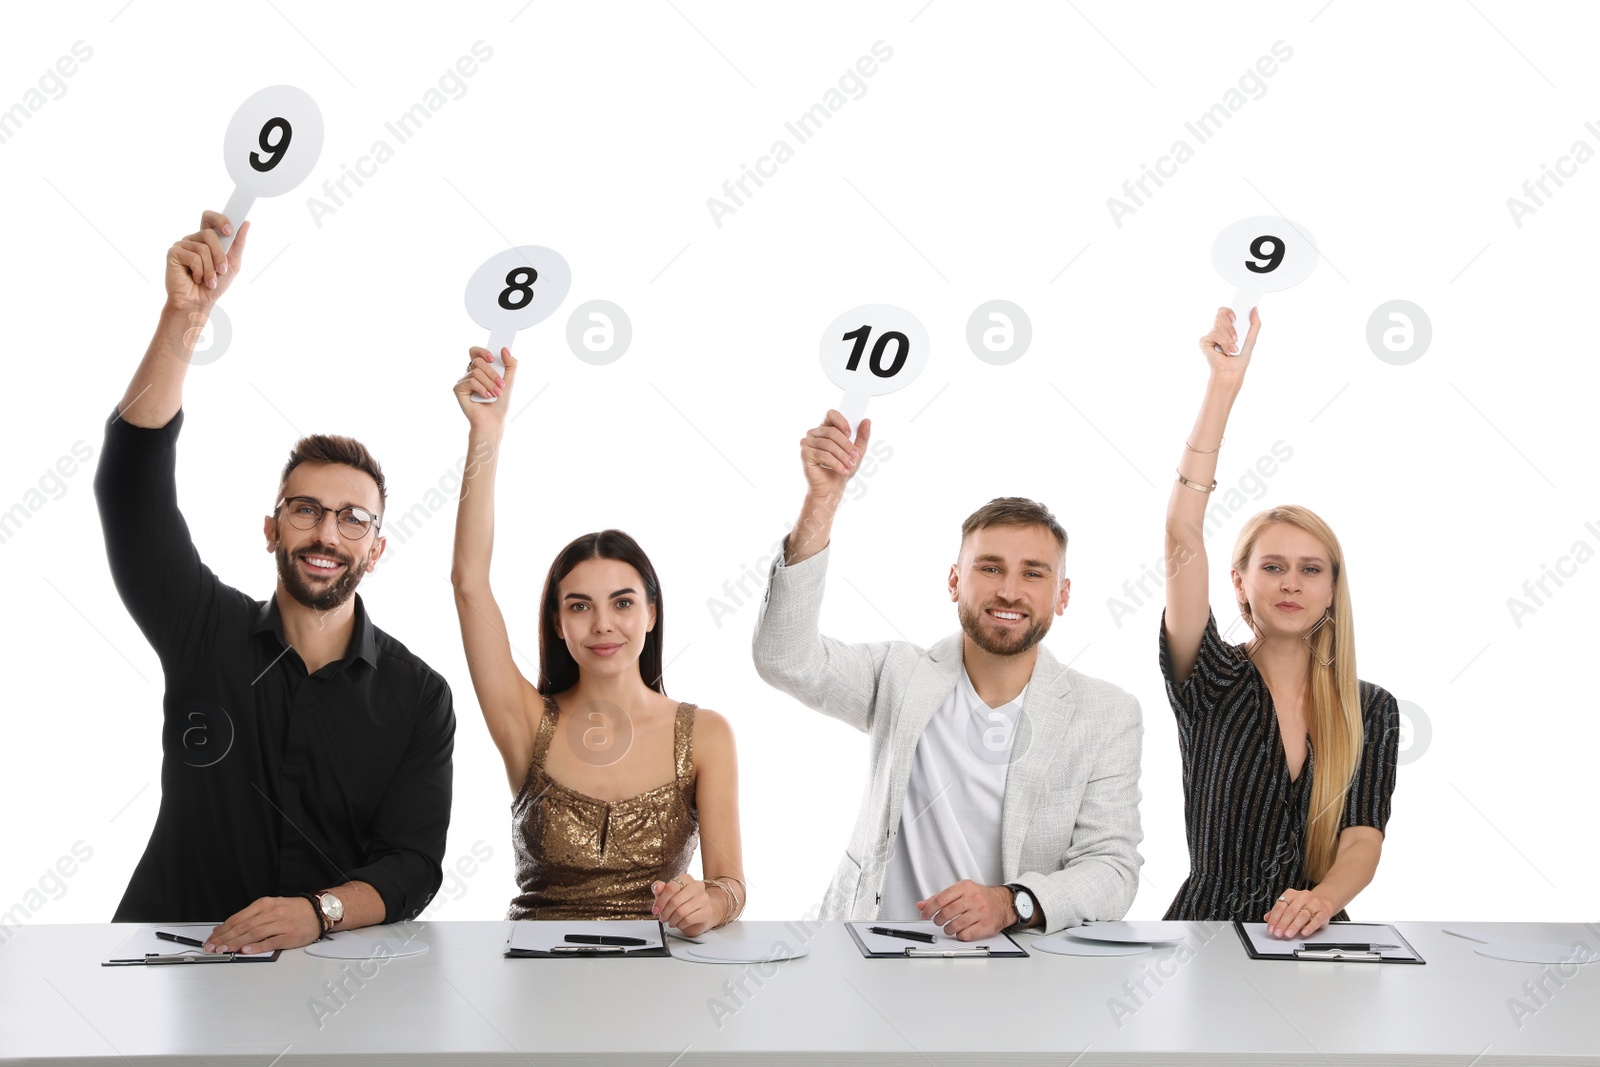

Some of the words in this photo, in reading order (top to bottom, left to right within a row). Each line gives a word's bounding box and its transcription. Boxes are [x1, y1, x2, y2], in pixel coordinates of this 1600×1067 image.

[249, 117, 292, 172] 9
[1246, 236, 1285, 273] 9
[498, 267, 538, 310] 8
[842, 325, 909, 378] 10
